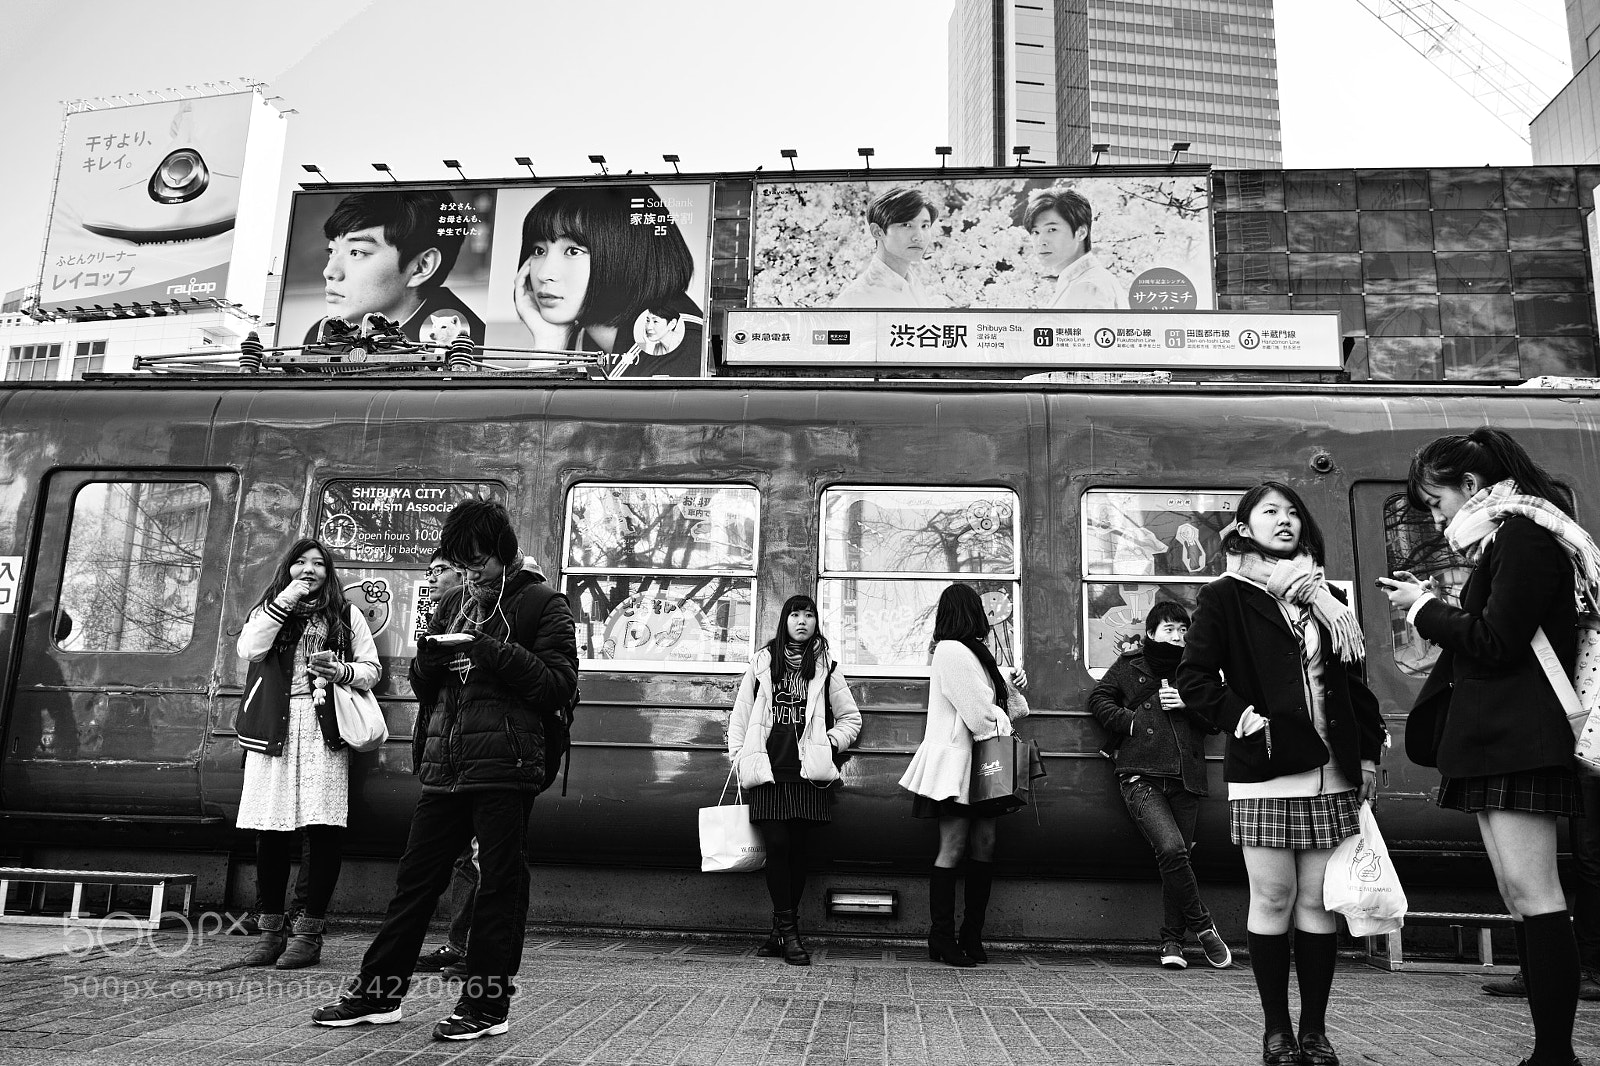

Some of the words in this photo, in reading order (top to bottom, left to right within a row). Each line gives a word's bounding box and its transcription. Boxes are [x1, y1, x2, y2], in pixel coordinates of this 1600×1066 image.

[85, 131, 152, 152] 干すより、
[82, 154, 132, 173] キレイ。
[440, 202, 476, 211] お父さん、
[438, 214, 482, 224] お母さんも、
[654, 225, 668, 236] 25
[56, 250, 137, 267] ふとんクリーナー
[51, 266, 136, 291] レイコップ
[166, 277, 217, 296] raycop
[1133, 291, 1193, 304] サクラミチ
[976, 323, 1008, 334] Shibuya
[1009, 323, 1025, 333] Sta.
[890, 323, 968, 349] 渋谷駅
[1036, 336, 1050, 346] 01
[1168, 338, 1181, 347] 01
[1244, 338, 1254, 346] 01
[352, 487, 412, 499] SHIBUYA
[415, 488, 446, 499] CITY
[351, 501, 403, 512] Tourism
[406, 501, 456, 512] Associa
[358, 532, 382, 542] open
[384, 530, 410, 541] hours
[357, 543, 386, 553] closed
[388, 545, 397, 553] in
[400, 545, 417, 553] bad
